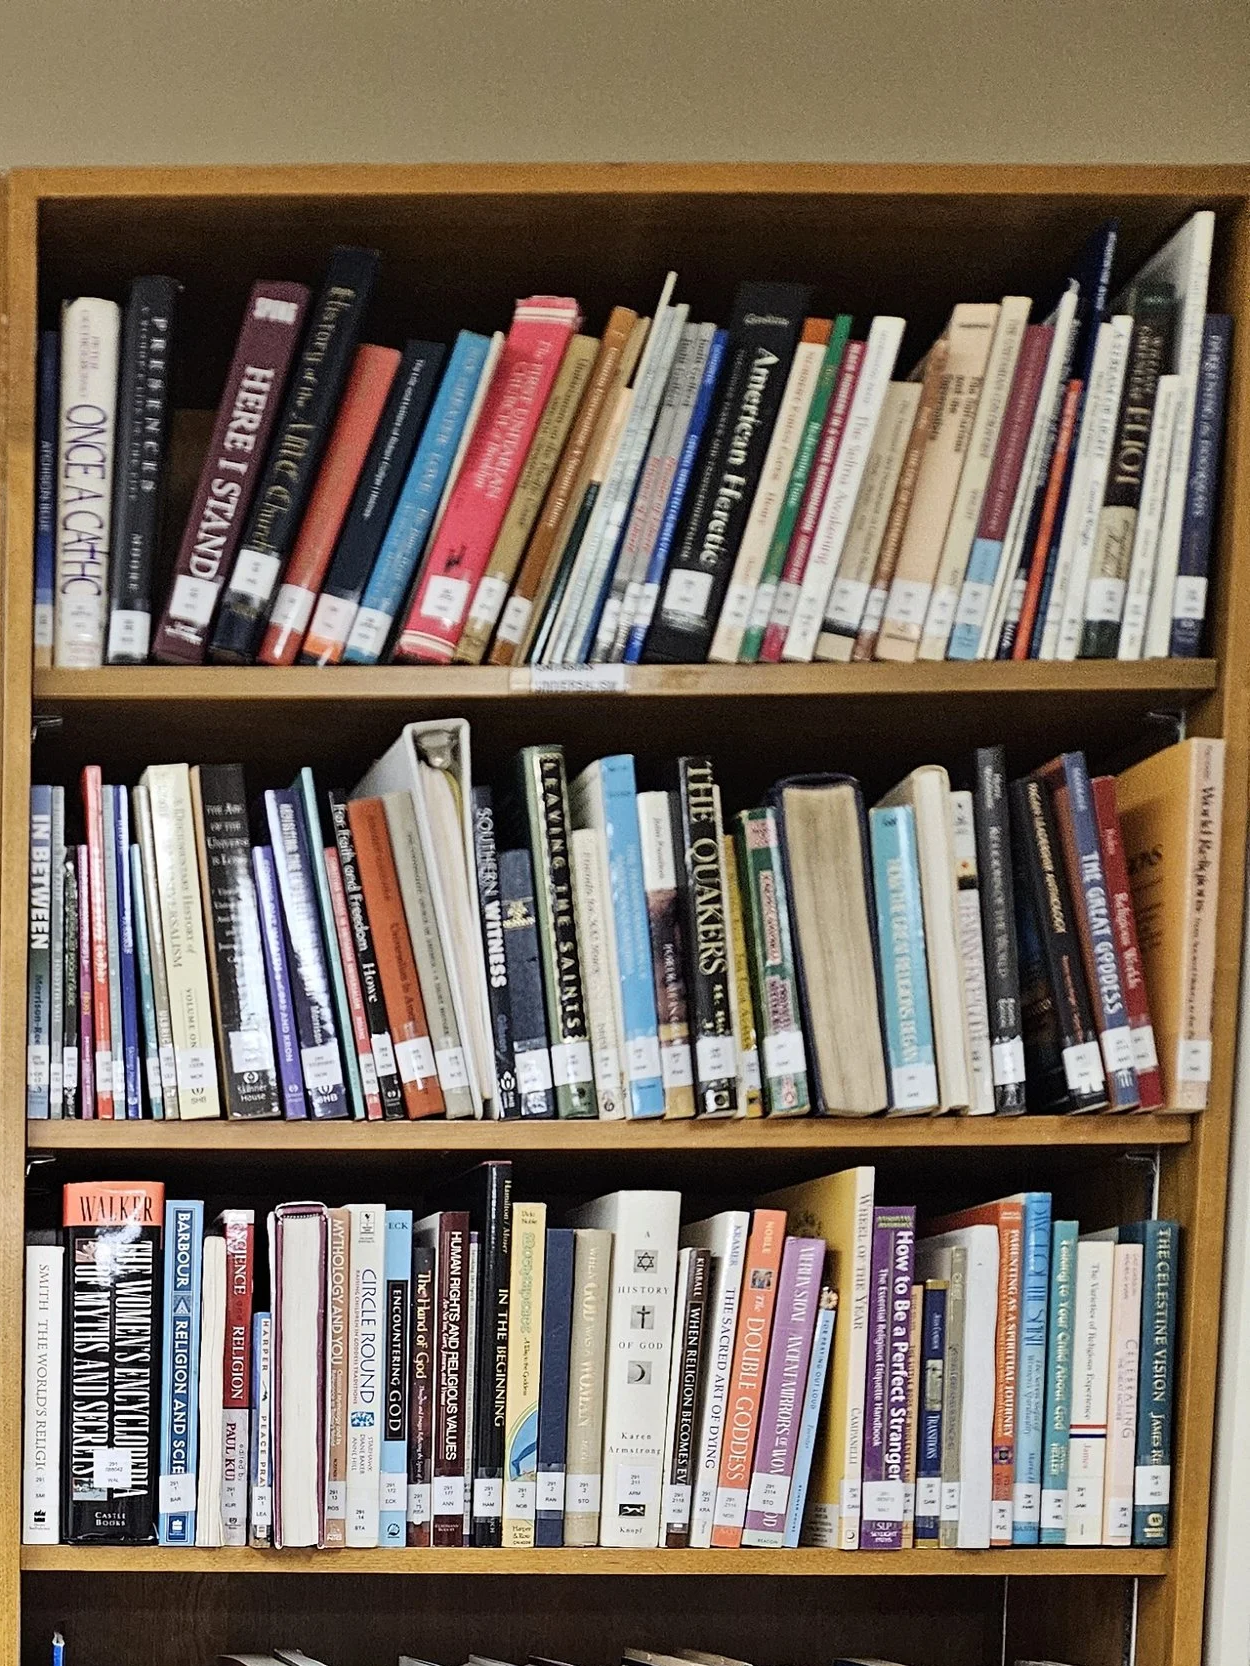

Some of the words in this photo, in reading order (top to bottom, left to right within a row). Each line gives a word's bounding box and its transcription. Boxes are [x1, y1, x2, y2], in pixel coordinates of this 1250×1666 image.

[223, 364, 275, 452] HERE
[727, 347, 781, 466] American
[217, 457, 246, 474] I
[189, 478, 243, 581] STAND
[699, 474, 747, 565] Heretic
[540, 759, 566, 870] LEAVING
[687, 761, 714, 824] THE
[31, 814, 49, 845] IN
[476, 807, 499, 897] SOUTHERN
[1082, 850, 1101, 883] THE
[30, 850, 49, 950] BETWEEN
[555, 884, 573, 927] THE
[691, 837, 728, 976] QUAKERS
[1087, 887, 1110, 937] GREAT
[484, 899, 507, 988] WITNESS
[558, 941, 584, 1029] SAINTS
[1097, 942, 1123, 1015] GODDESS
[80, 1195, 153, 1222] WALKER
[450, 1231, 462, 1275] HUMAN
[1157, 1228, 1172, 1259] THE
[360, 1269, 378, 1327] CIRCLE
[448, 1277, 461, 1322] RIGHTS
[617, 1288, 669, 1296] HISTORY
[724, 1287, 736, 1315] THE
[753, 1294, 767, 1313] The
[1154, 1261, 1170, 1337] CELESTINE
[389, 1289, 403, 1387] ENCOUNTERING
[448, 1324, 460, 1349] AND
[618, 1341, 635, 1351] OF
[639, 1342, 663, 1351] GOD
[717, 1318, 732, 1371] SACRED
[738, 1318, 766, 1391] DOUBLE
[360, 1332, 377, 1405] ROUND
[446, 1351, 459, 1413] RELIGIOUS
[713, 1375, 725, 1401] ART
[1152, 1340, 1168, 1402] VISION
[388, 1390, 402, 1431] GOD
[445, 1415, 457, 1460] VALUES
[710, 1405, 721, 1423] OF
[705, 1426, 720, 1470] DYING
[726, 1397, 755, 1481] GODDESS
